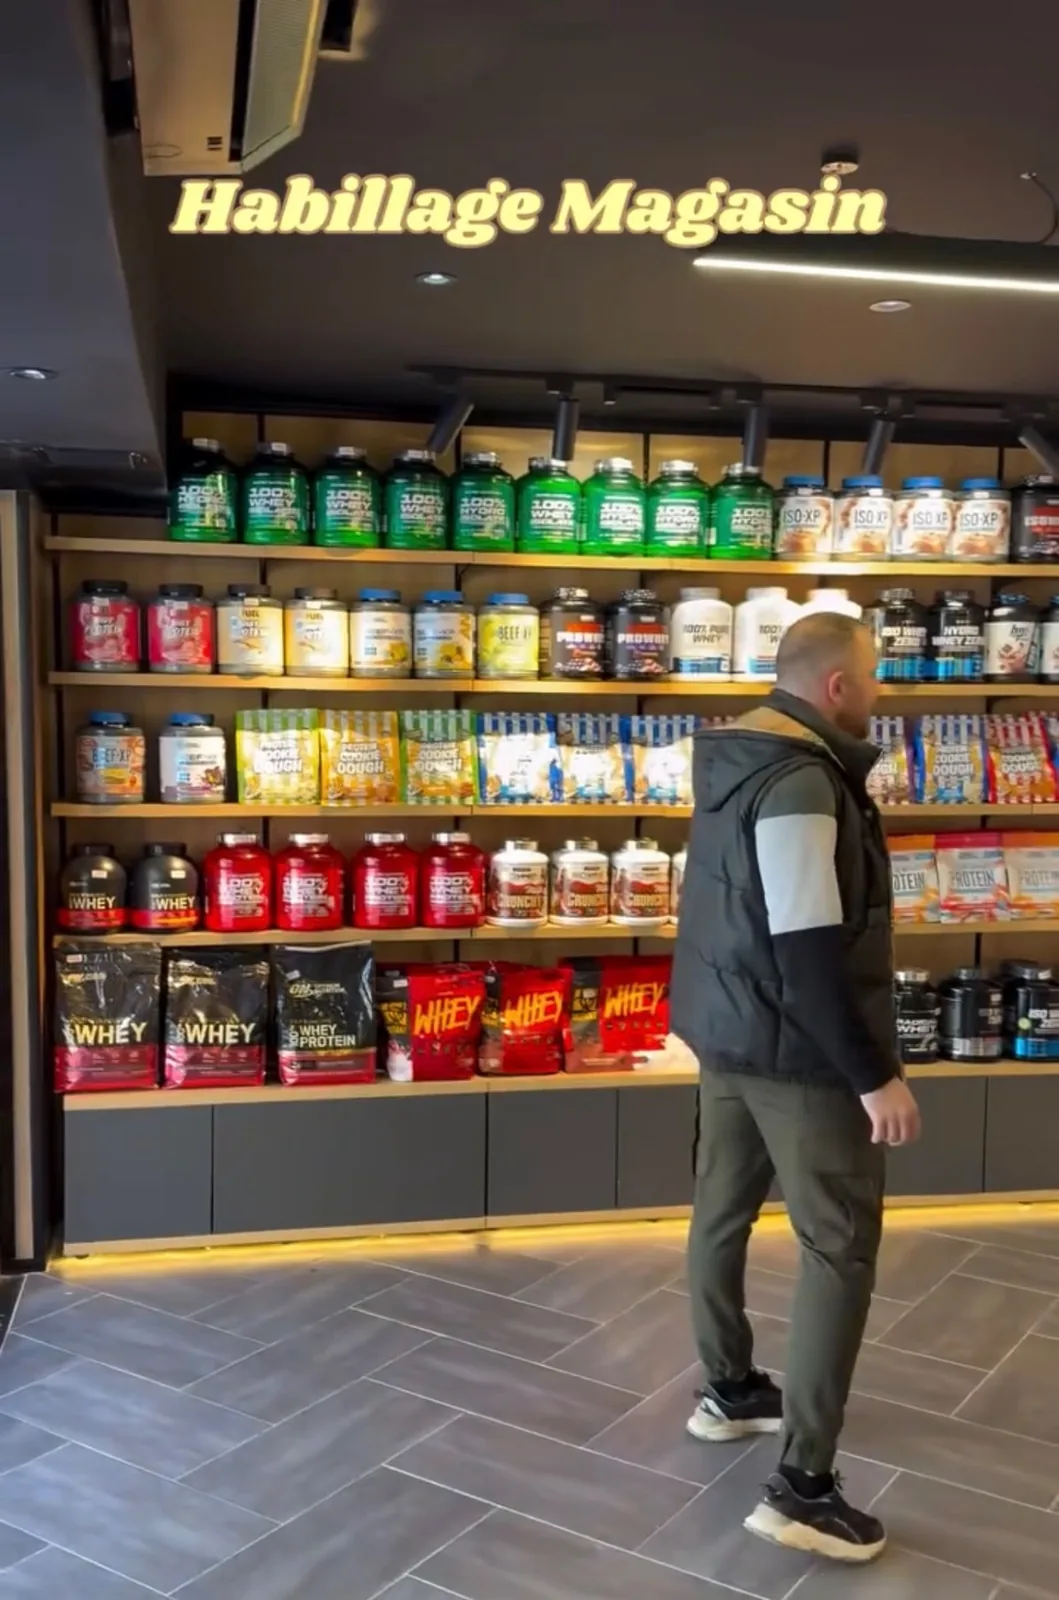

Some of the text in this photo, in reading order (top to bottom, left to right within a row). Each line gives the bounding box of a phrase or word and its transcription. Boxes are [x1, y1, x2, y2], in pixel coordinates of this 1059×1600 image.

[247, 499, 294, 508] WHEY
[401, 505, 443, 513] WHEY
[76, 896, 116, 910] WHEY
[156, 896, 196, 910] WHEY
[604, 981, 667, 1018] WHEY
[412, 995, 481, 1036] WHEY
[503, 991, 564, 1029] WHEY
[74, 1022, 148, 1044] WHEY
[184, 1022, 256, 1044] WHEY
[300, 1024, 337, 1036] WHEY
[300, 1034, 356, 1048] PROTEIN
